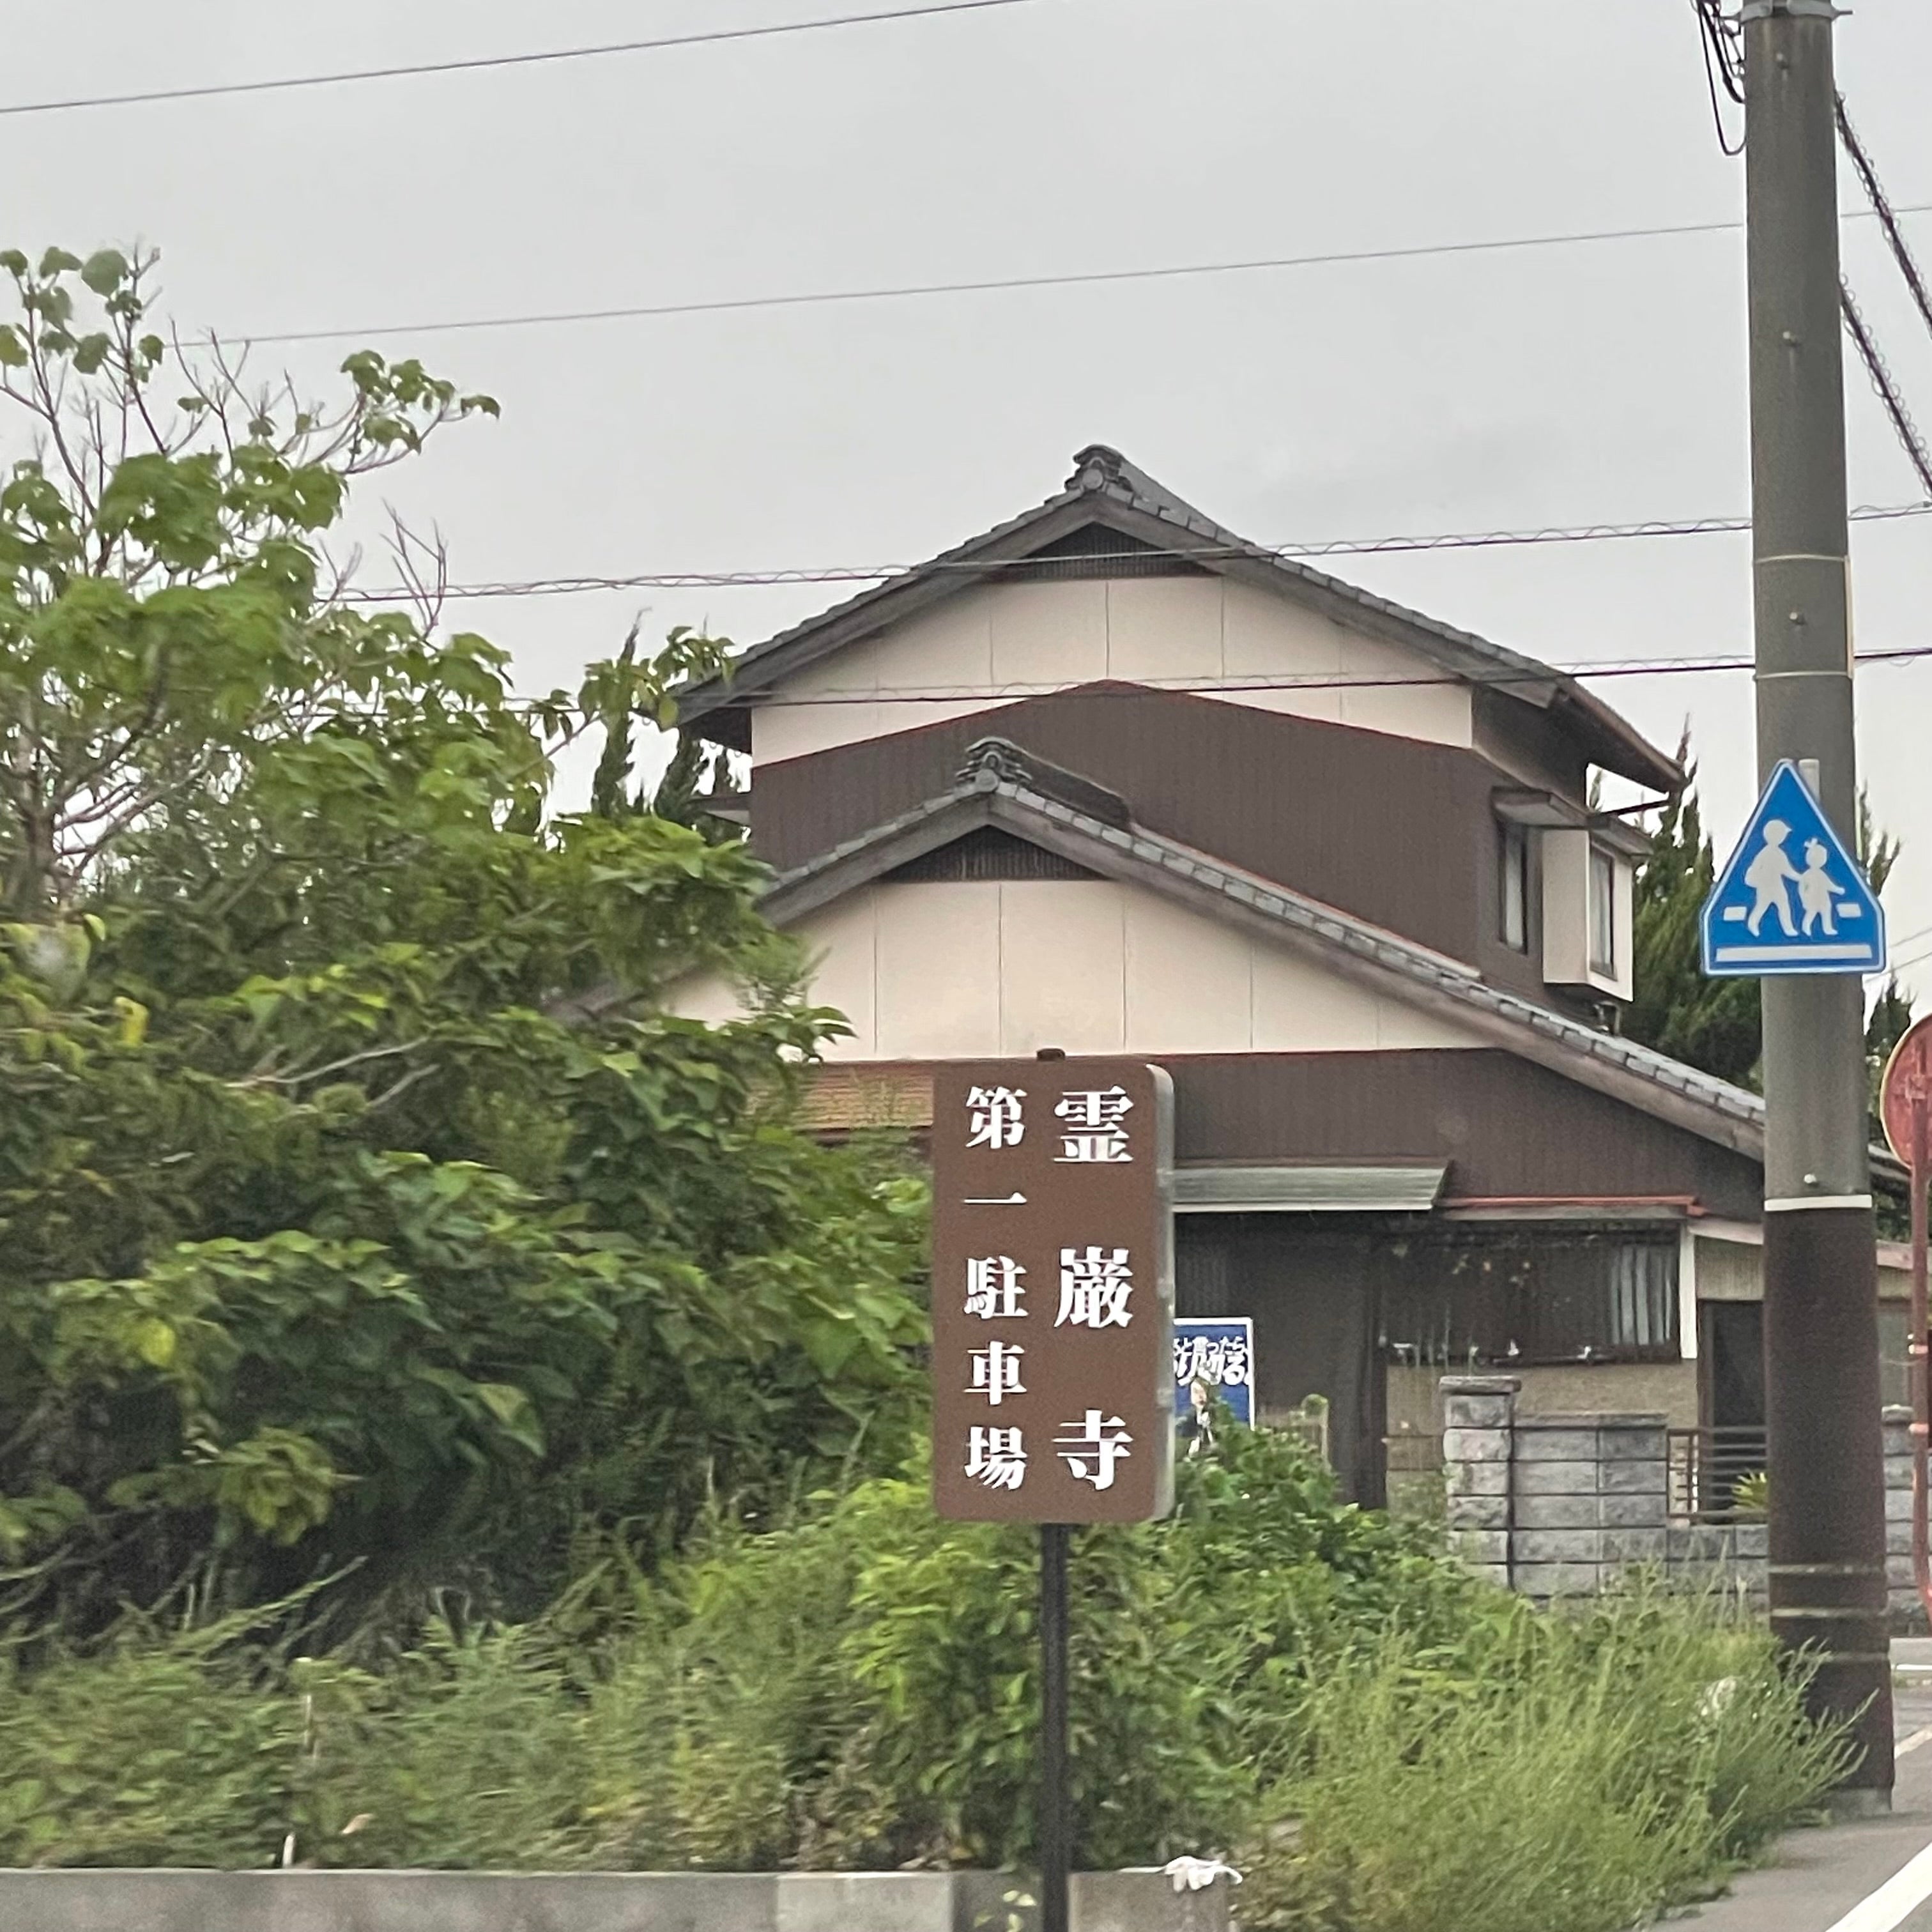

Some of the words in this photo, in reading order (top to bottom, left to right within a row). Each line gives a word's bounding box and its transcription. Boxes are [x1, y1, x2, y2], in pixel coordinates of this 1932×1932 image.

[963, 1086, 1028, 1490] 第一駐車場
[1052, 1085, 1134, 1490] 霊巌寺
